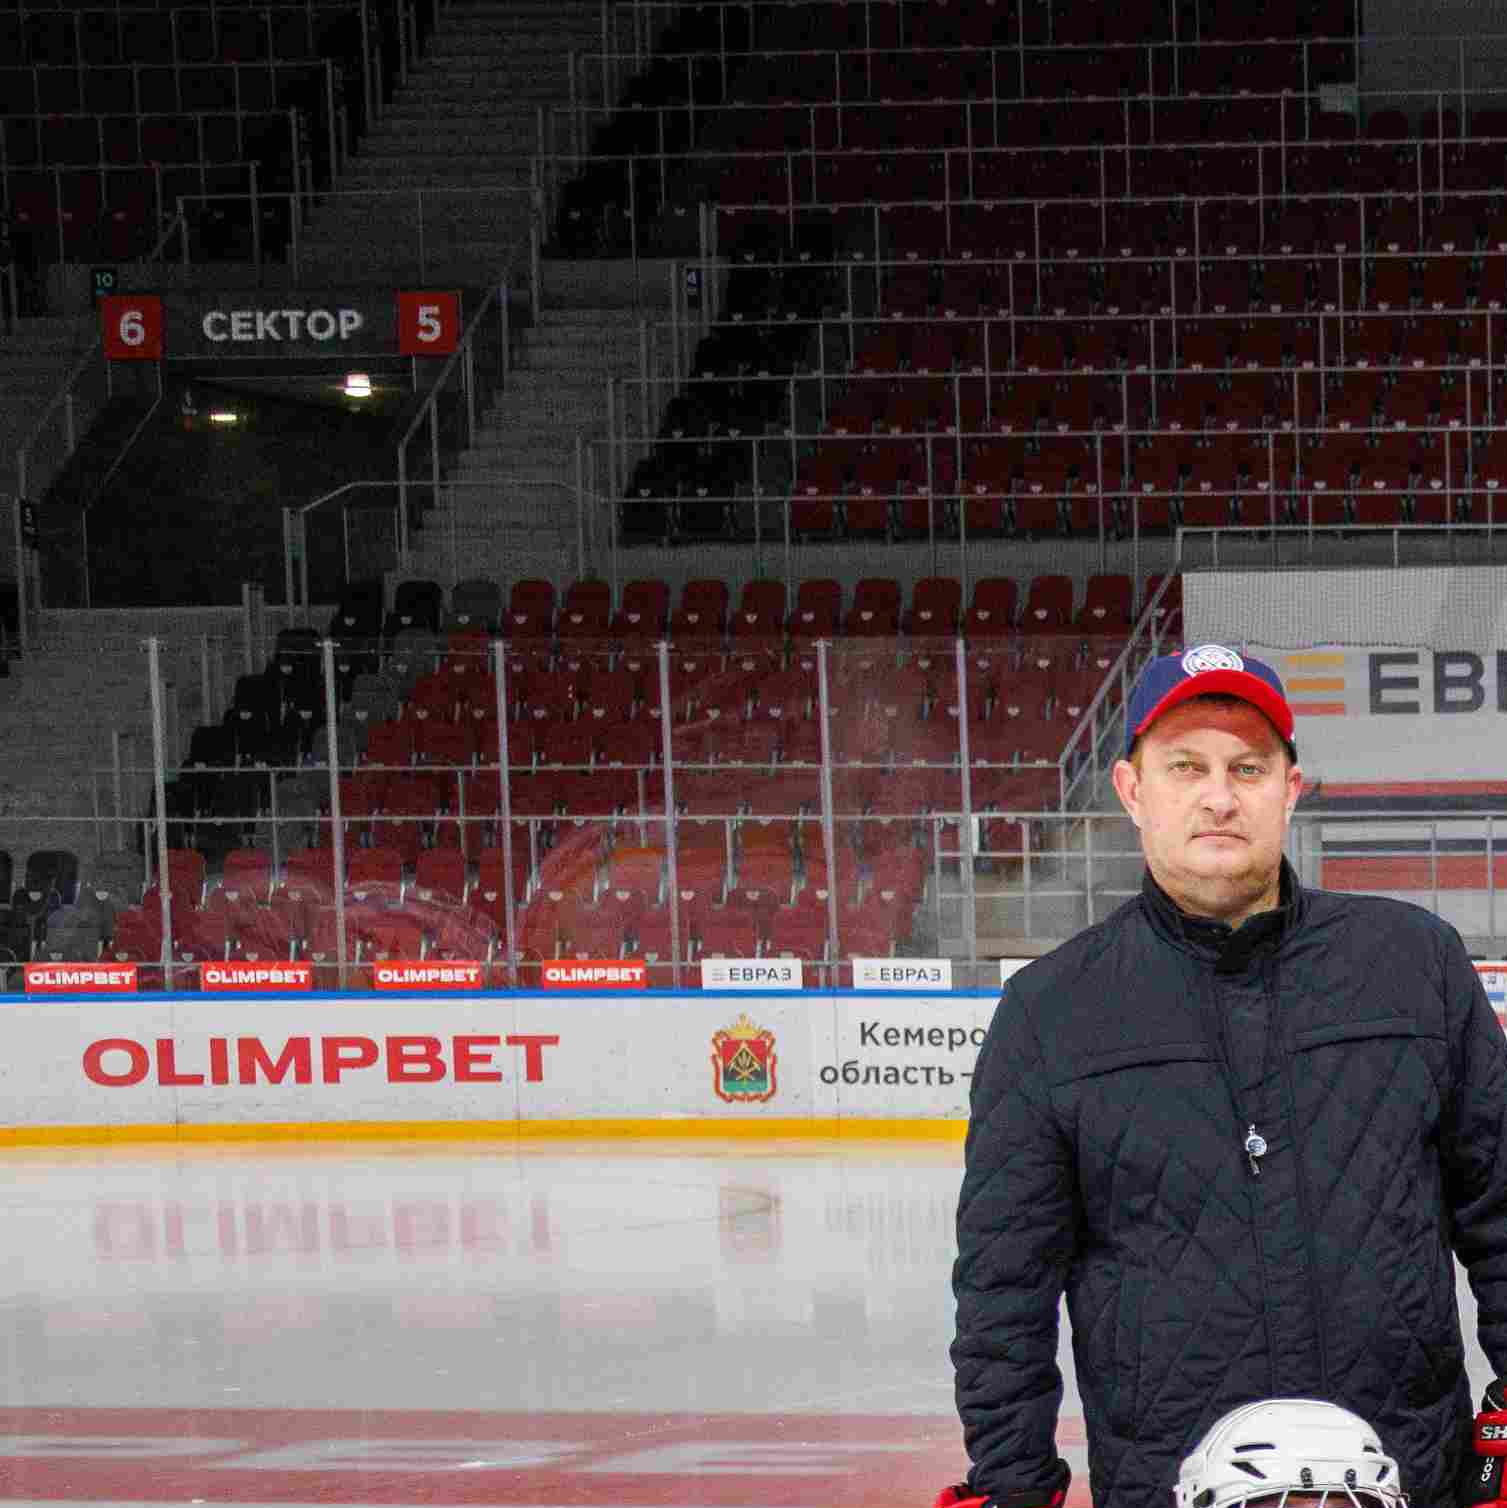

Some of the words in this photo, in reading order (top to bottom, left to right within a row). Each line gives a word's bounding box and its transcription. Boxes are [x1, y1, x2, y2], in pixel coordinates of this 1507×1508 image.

[119, 311, 146, 346] 6
[201, 308, 364, 342] СЕКТОР
[416, 305, 441, 343] 5
[27, 969, 135, 986] OLIMPBET
[205, 968, 310, 985] OLIMPBET
[377, 967, 479, 984] OLIMPBET
[545, 966, 645, 983] OLIMPBET
[729, 966, 793, 982] ЕВРАЗ
[879, 966, 942, 983] ЕВРАЗ
[81, 1034, 561, 1088] OLIMPBET
